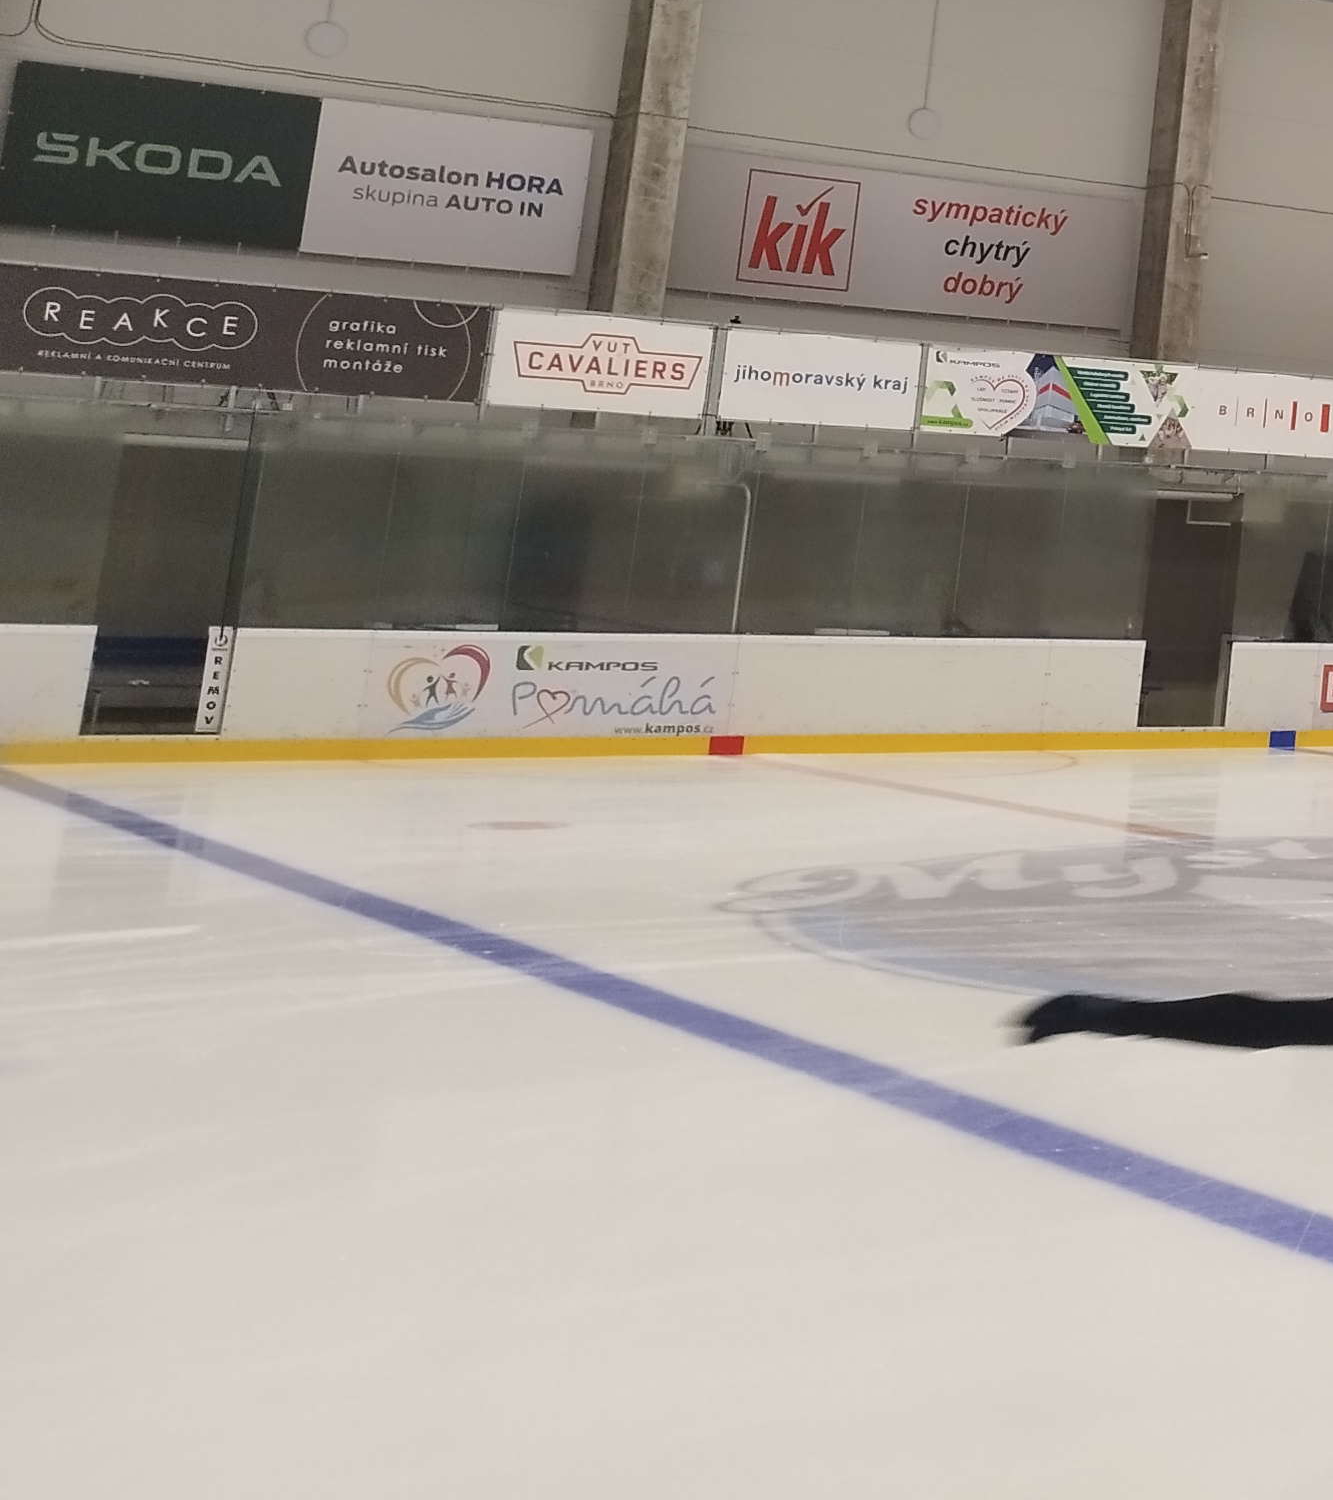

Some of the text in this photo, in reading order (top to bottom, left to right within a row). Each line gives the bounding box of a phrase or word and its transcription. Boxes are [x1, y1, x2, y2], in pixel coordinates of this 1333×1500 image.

[337, 154, 564, 197] Autosalon HORA
[352, 182, 544, 218] skupina AUTO IN
[912, 197, 1068, 236] sympatický
[943, 235, 1031, 268] chytrý
[943, 271, 1024, 304] dobrý
[43, 301, 239, 338] REAKCE
[329, 319, 397, 334] grafika
[325, 338, 448, 358] reklamní tisk
[593, 341, 632, 354] VUT
[323, 358, 403, 373] montáže
[527, 351, 687, 382] CAVALIERS
[734, 364, 909, 394] jihomoravský kraj
[590, 380, 624, 390] BRNO
[547, 661, 658, 671] KAMPOS
[614, 723, 714, 736] www.kampos.cz
